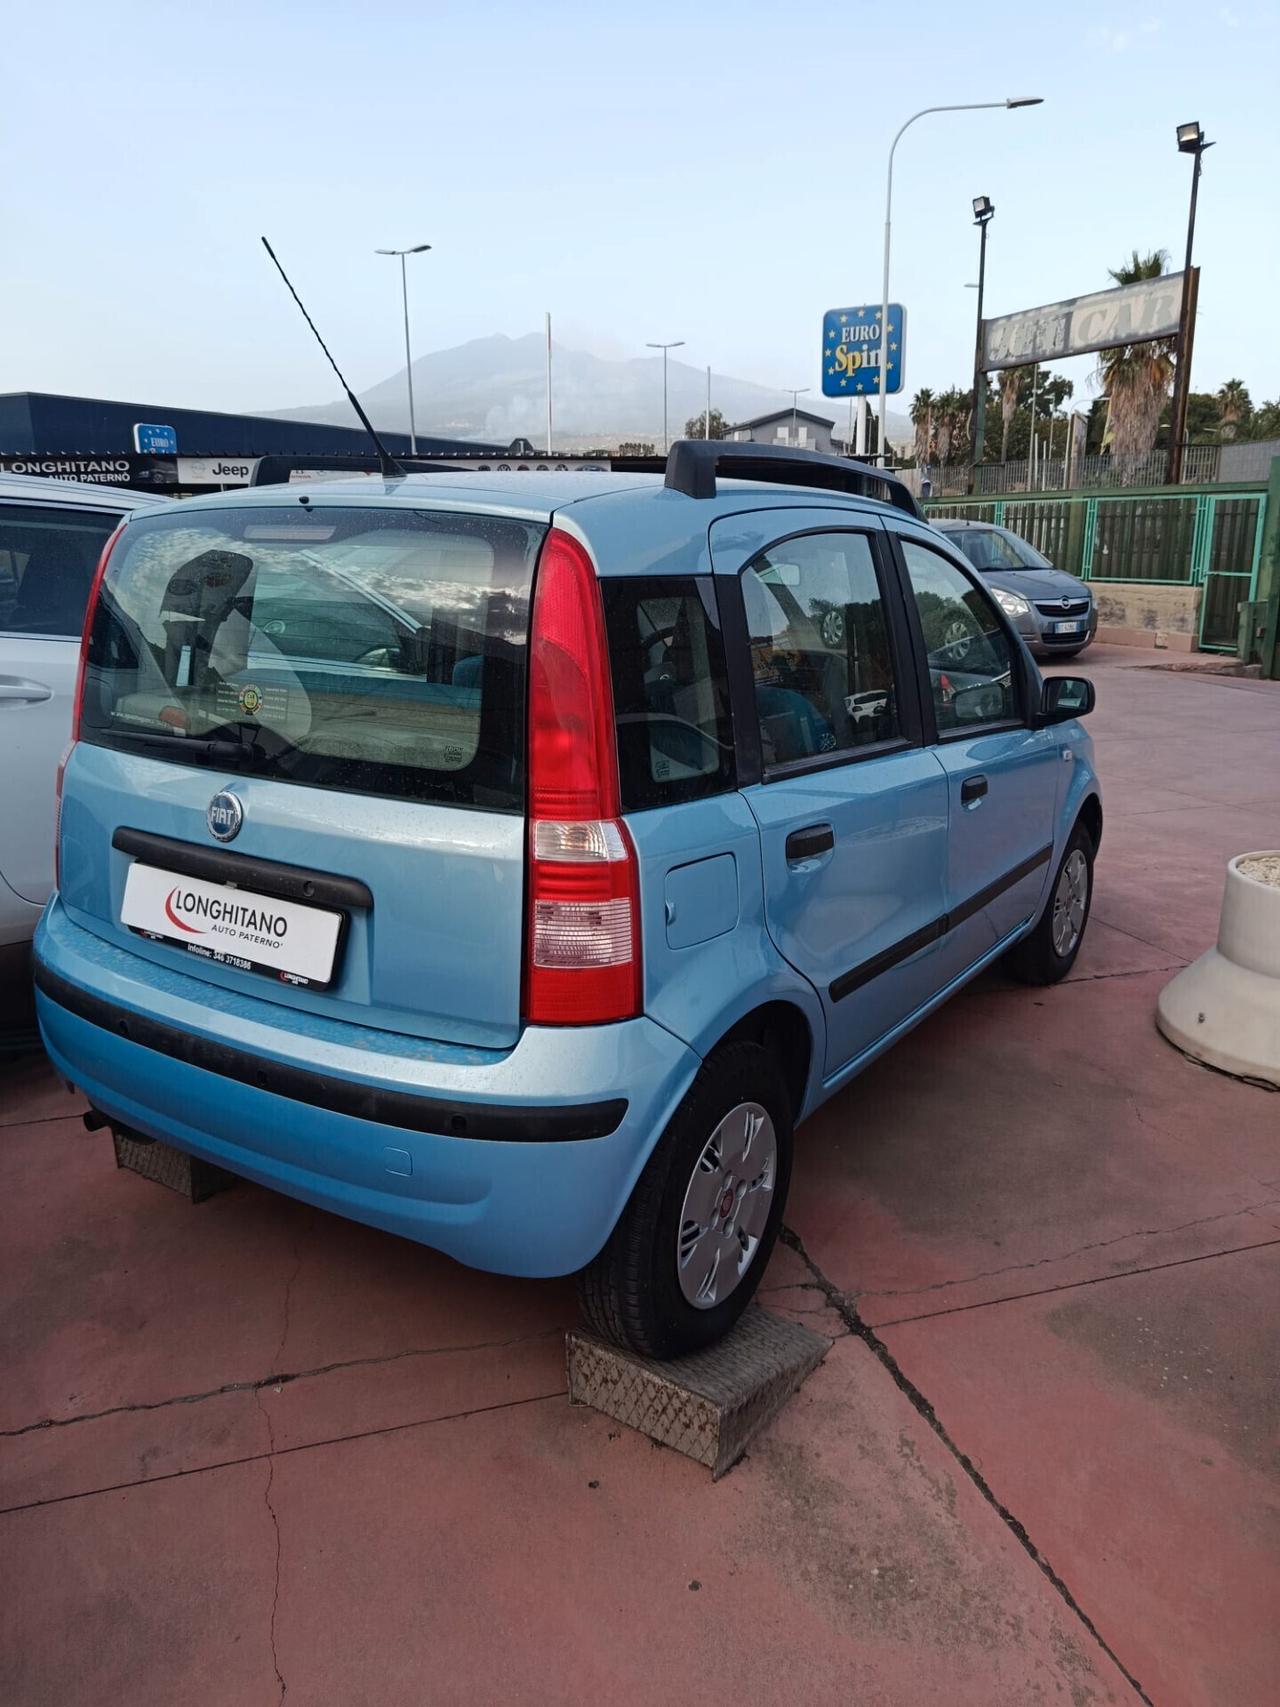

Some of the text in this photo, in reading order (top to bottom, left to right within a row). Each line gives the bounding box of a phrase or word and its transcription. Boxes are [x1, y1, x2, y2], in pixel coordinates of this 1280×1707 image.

[1078, 295, 1174, 342] CAR
[841, 324, 880, 343] EURO
[834, 344, 881, 377] Spin
[0, 460, 130, 473] LONGHITANO
[212, 462, 249, 479] Jeep
[80, 472, 131, 482] PATERNÒ
[211, 806, 234, 825] FIAT
[175, 890, 288, 938] LONGHITANO
[211, 924, 236, 937] AUTO
